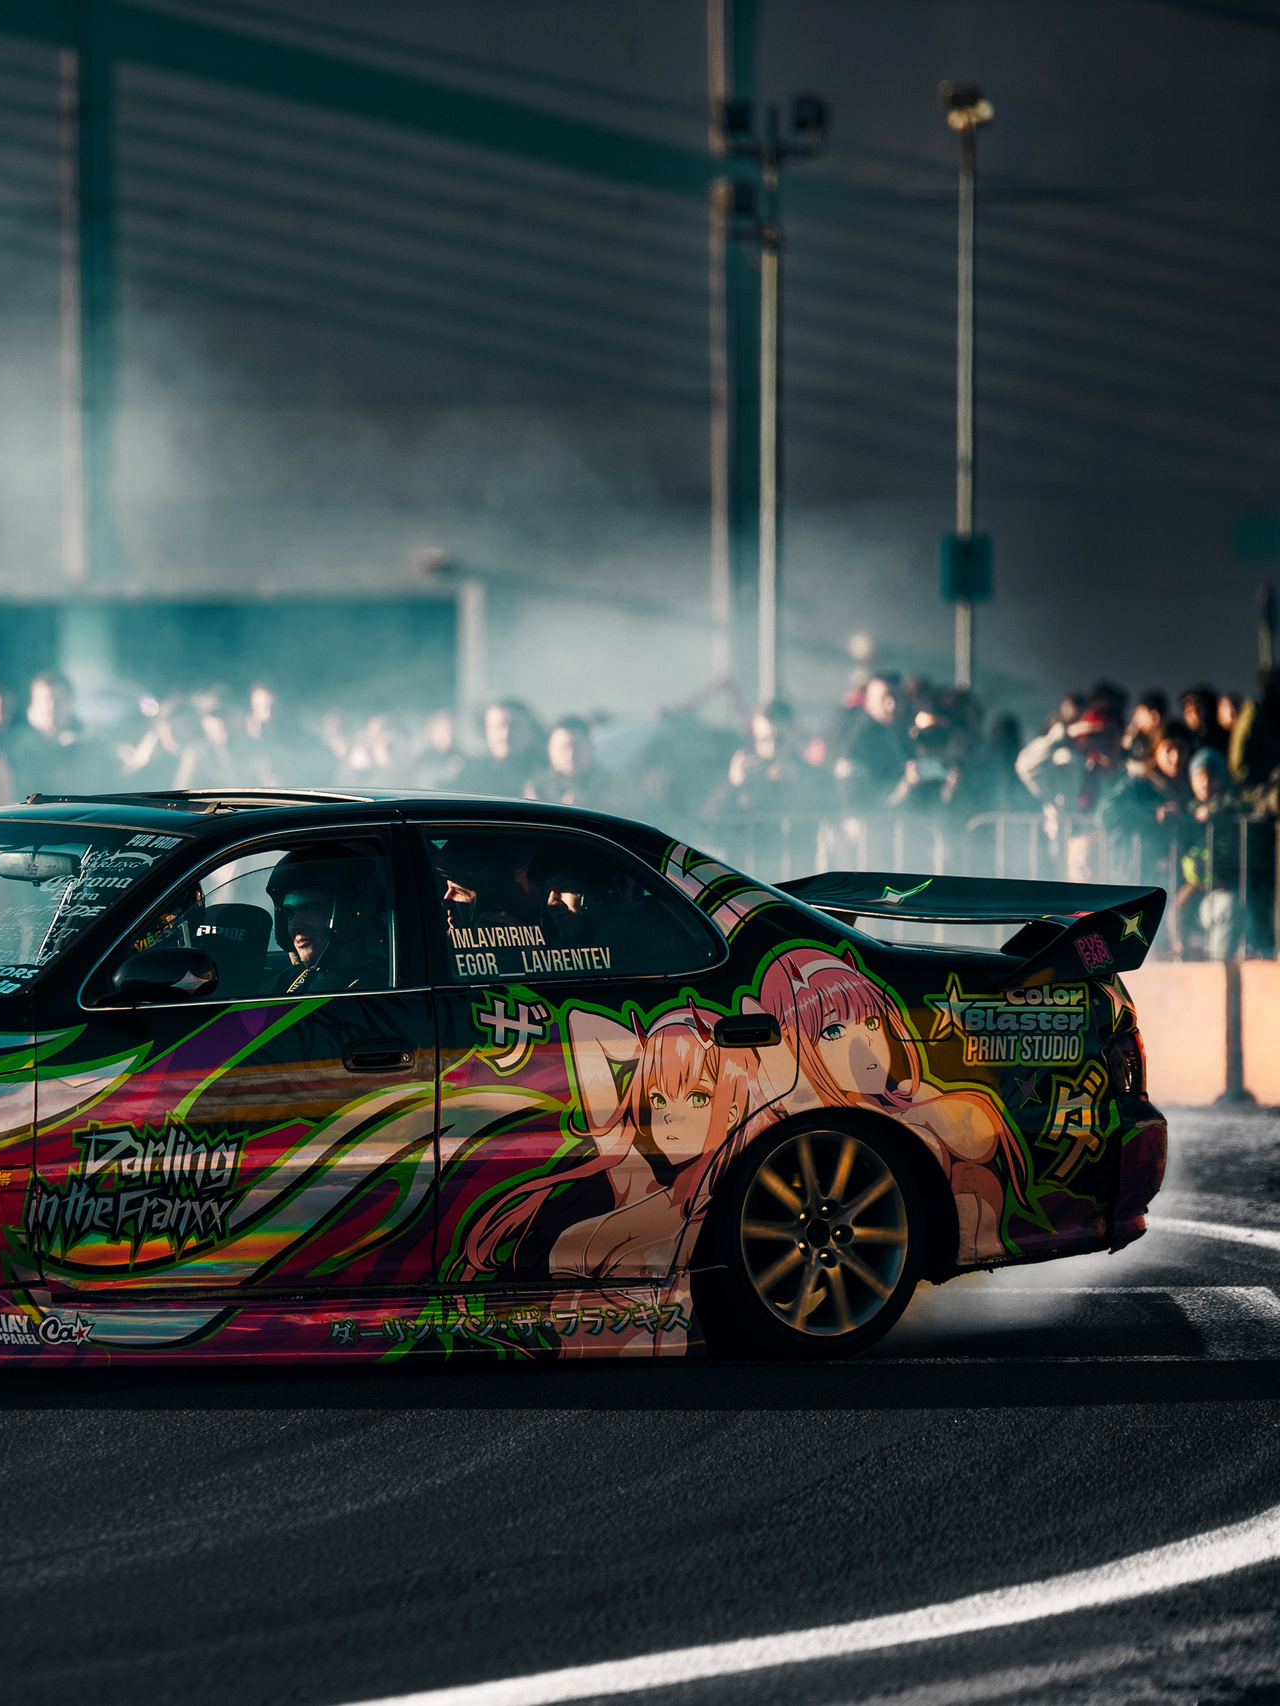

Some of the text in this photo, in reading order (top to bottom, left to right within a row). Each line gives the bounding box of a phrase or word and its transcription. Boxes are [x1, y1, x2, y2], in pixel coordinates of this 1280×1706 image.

[39, 874, 133, 892] Corona
[1006, 985, 1084, 1006] Color
[965, 1009, 1084, 1031] Blaster
[480, 1000, 548, 1068] ザ
[967, 1035, 1079, 1060] PRINT STUDIO
[81, 1126, 238, 1190] Darling
